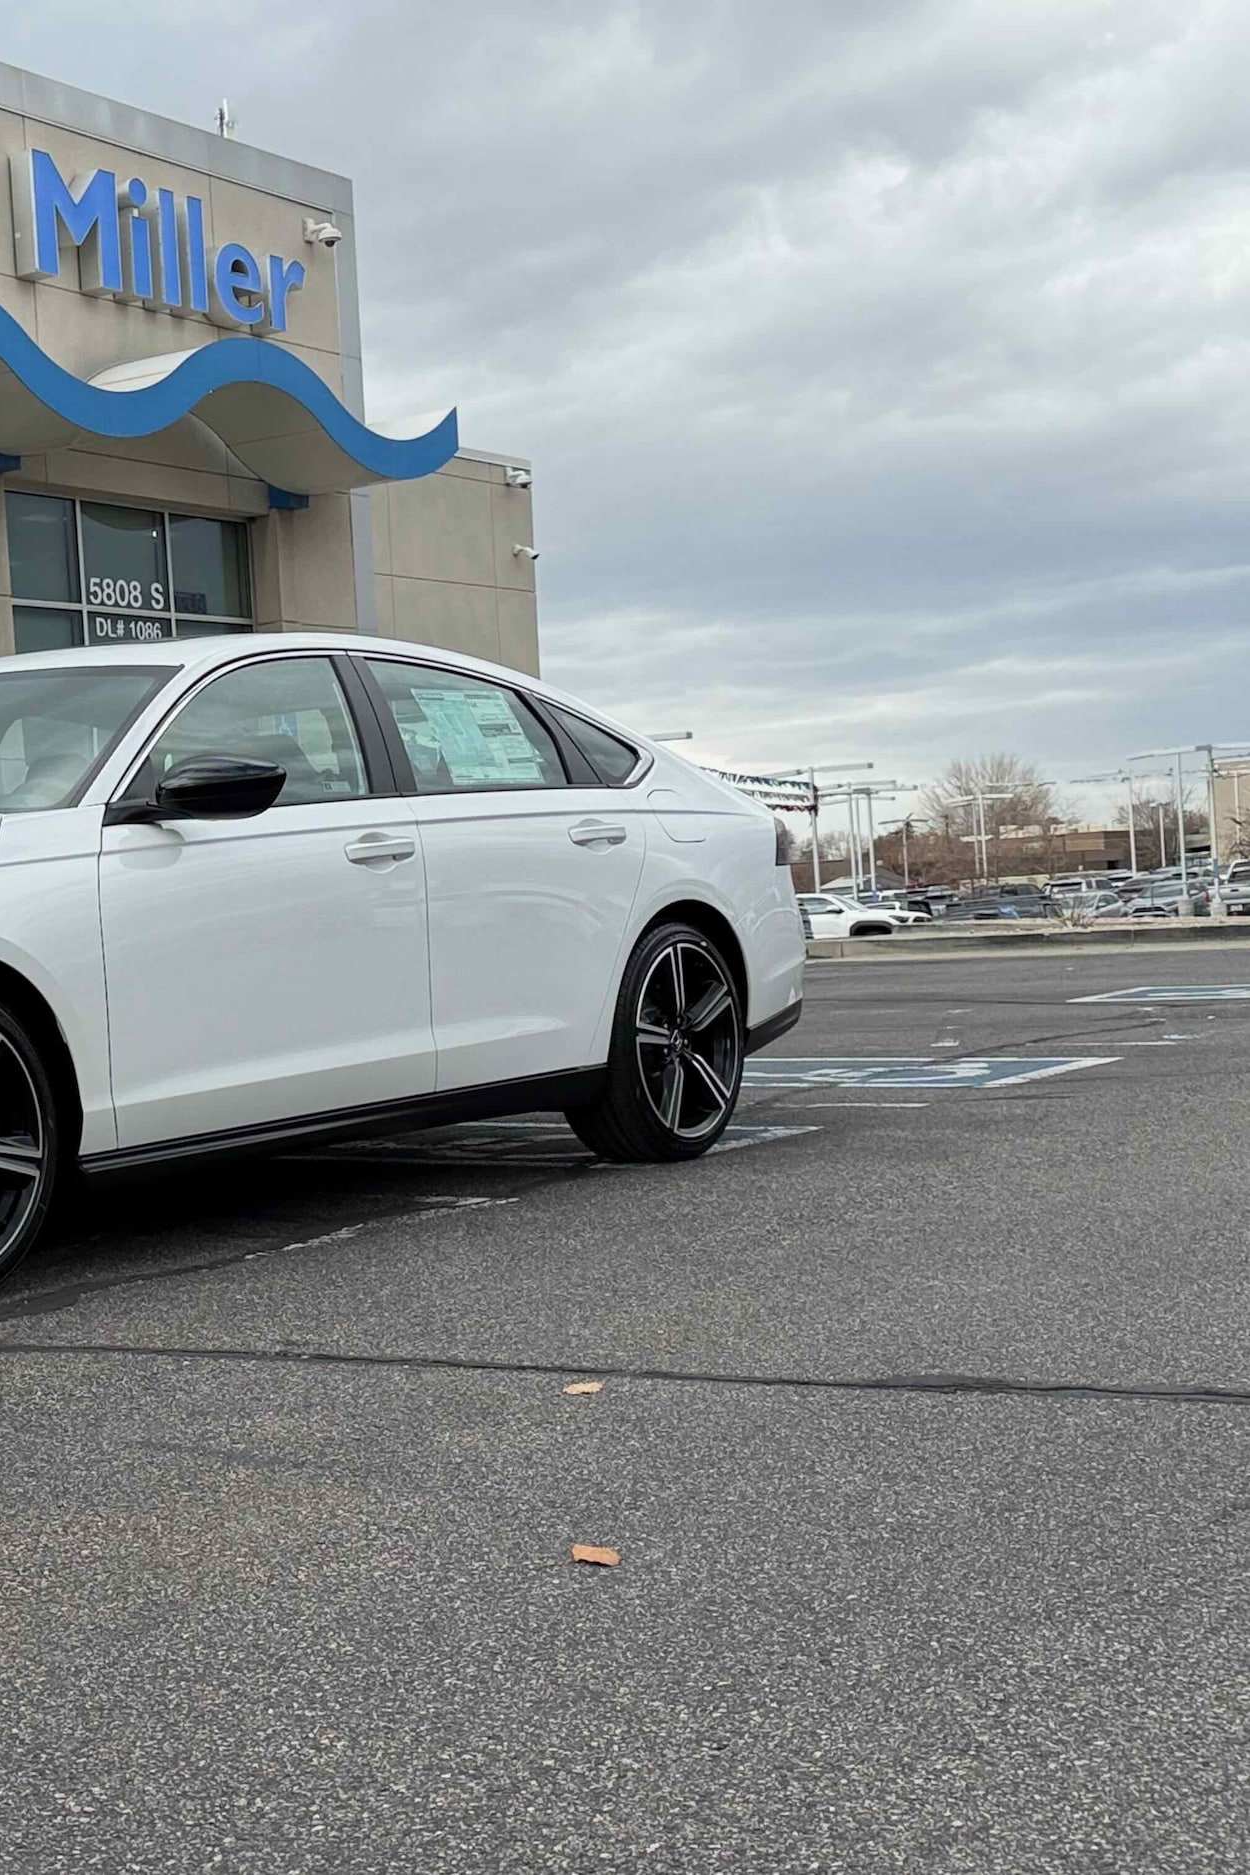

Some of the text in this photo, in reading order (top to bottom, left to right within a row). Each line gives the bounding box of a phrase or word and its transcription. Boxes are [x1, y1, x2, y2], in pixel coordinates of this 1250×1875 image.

[20, 148, 306, 333] Miller
[90, 577, 164, 609] 5808 S
[95, 617, 162, 640] DL# 1086
